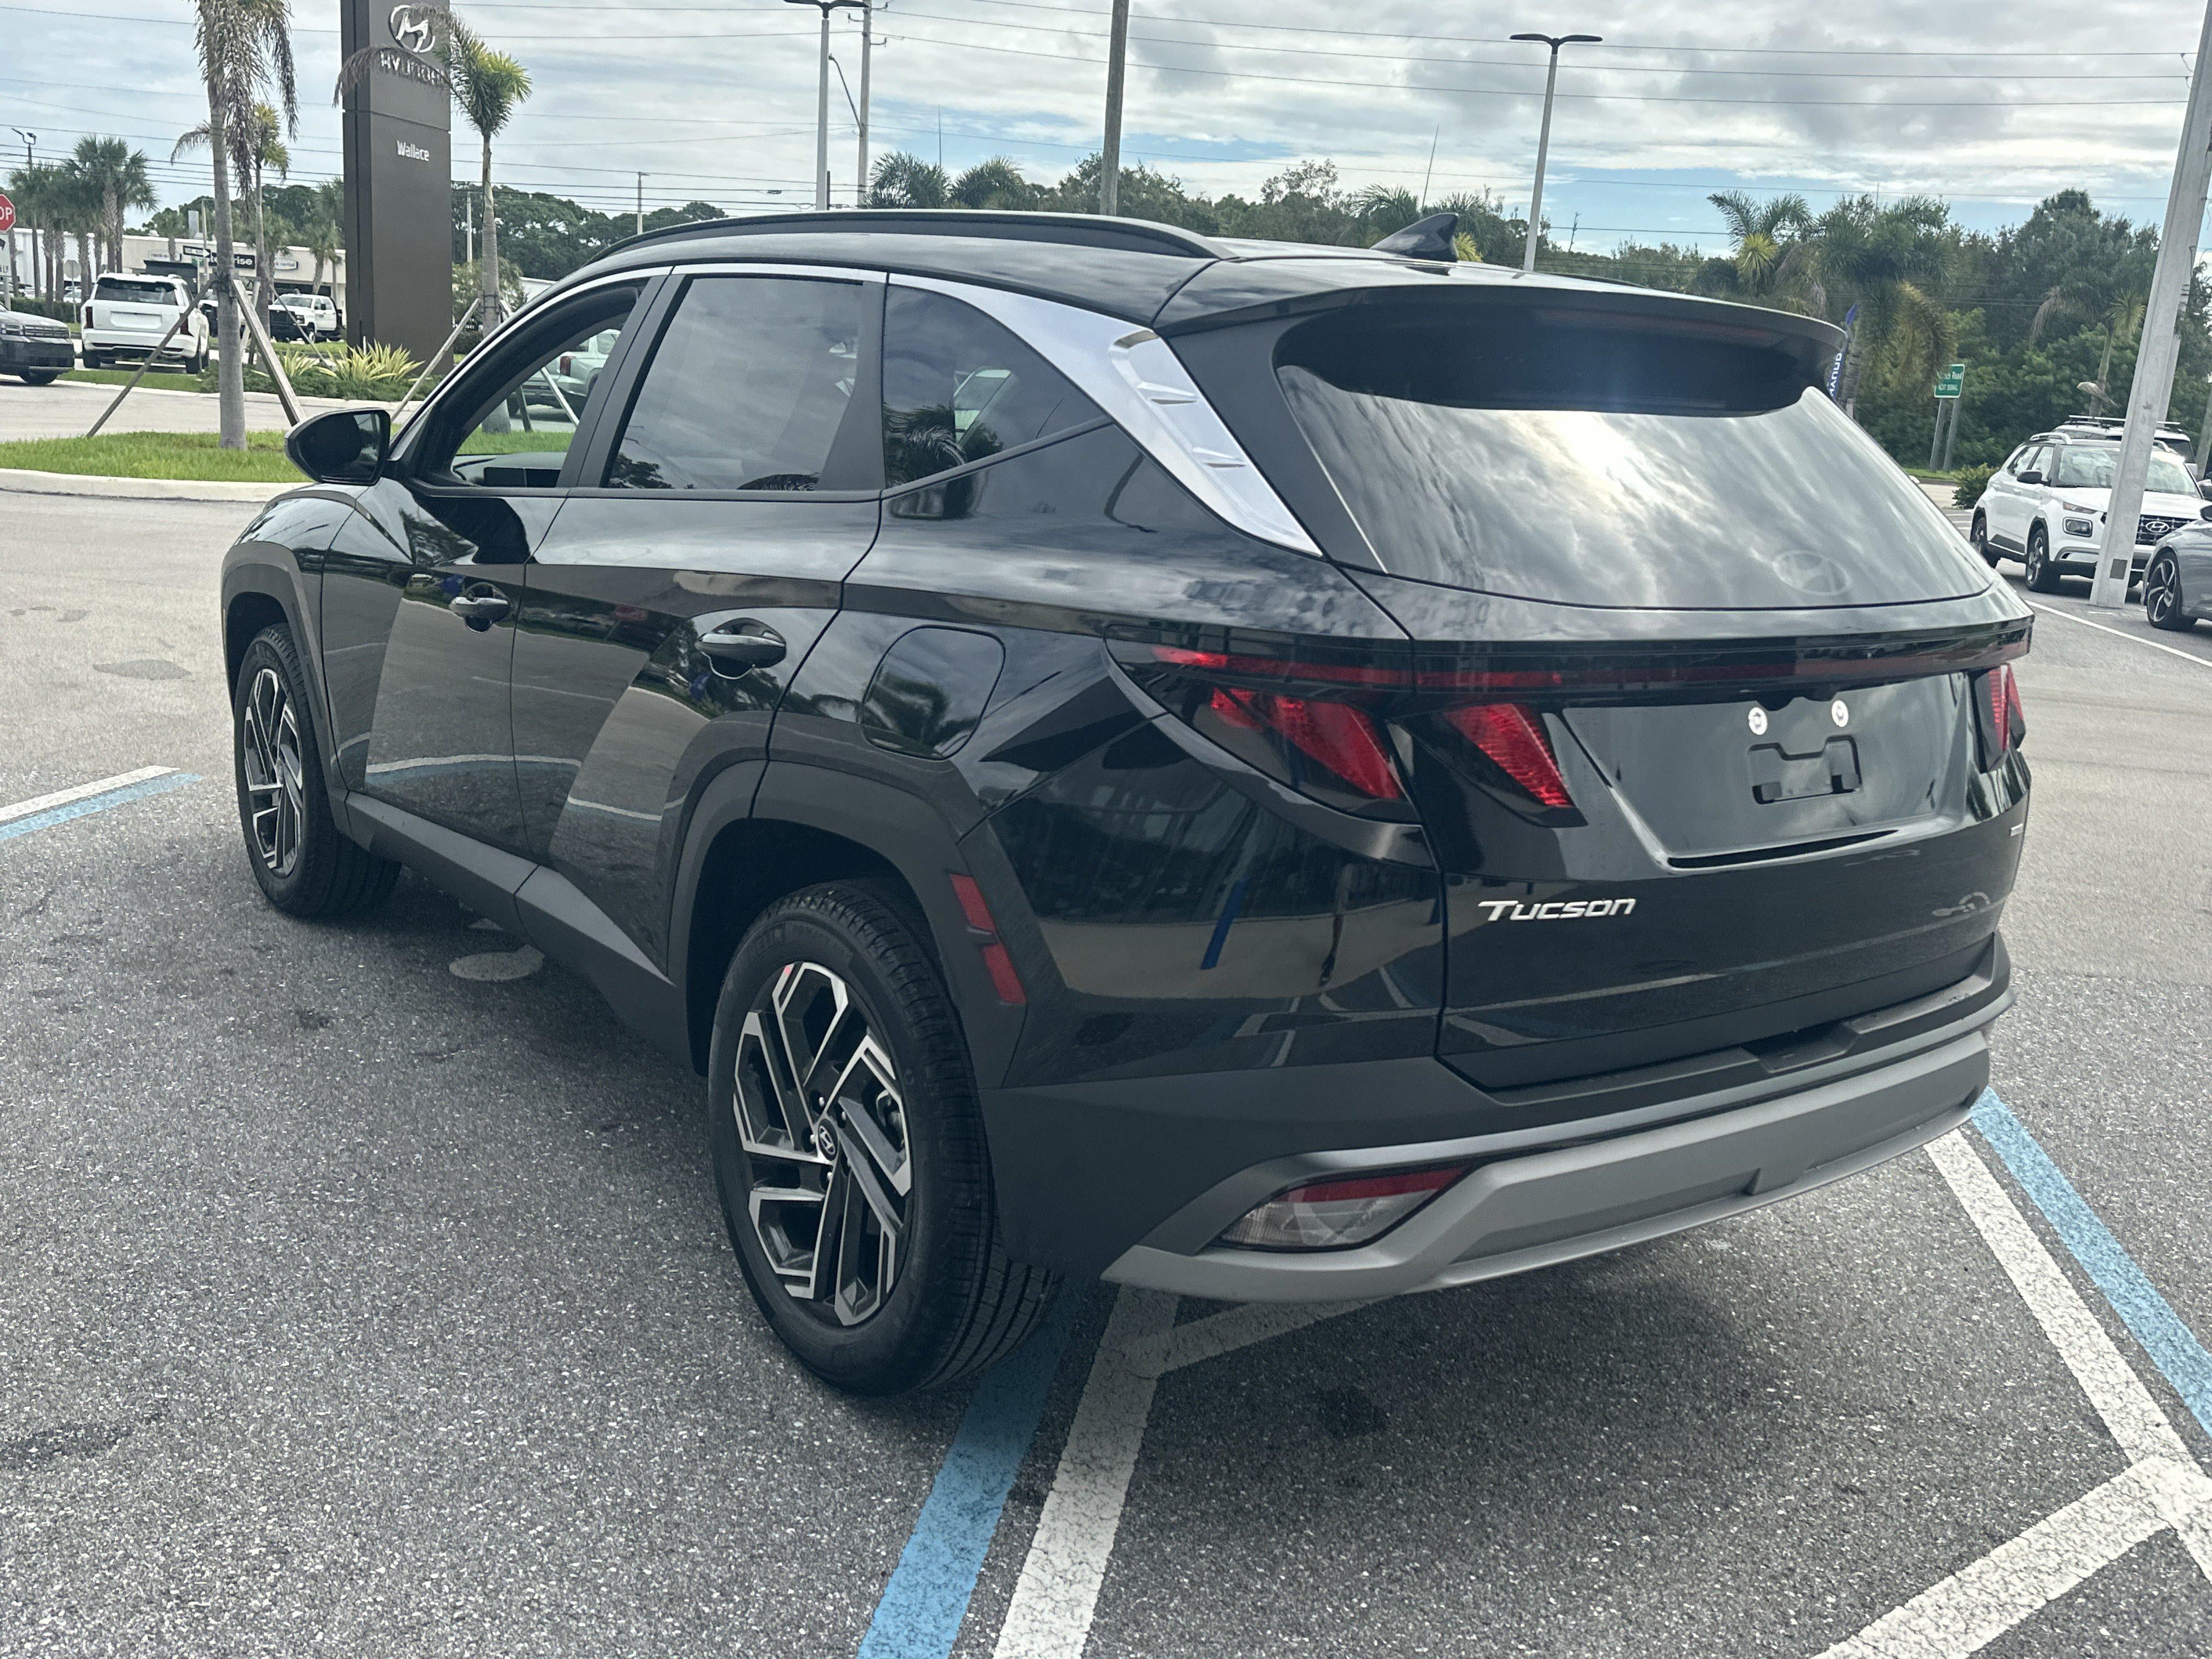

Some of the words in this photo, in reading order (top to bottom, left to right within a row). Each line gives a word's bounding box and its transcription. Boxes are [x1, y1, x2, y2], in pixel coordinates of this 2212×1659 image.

[397, 140, 430, 162] Wallace
[0, 207, 13, 221] OP
[1830, 352, 1843, 397] HYUND
